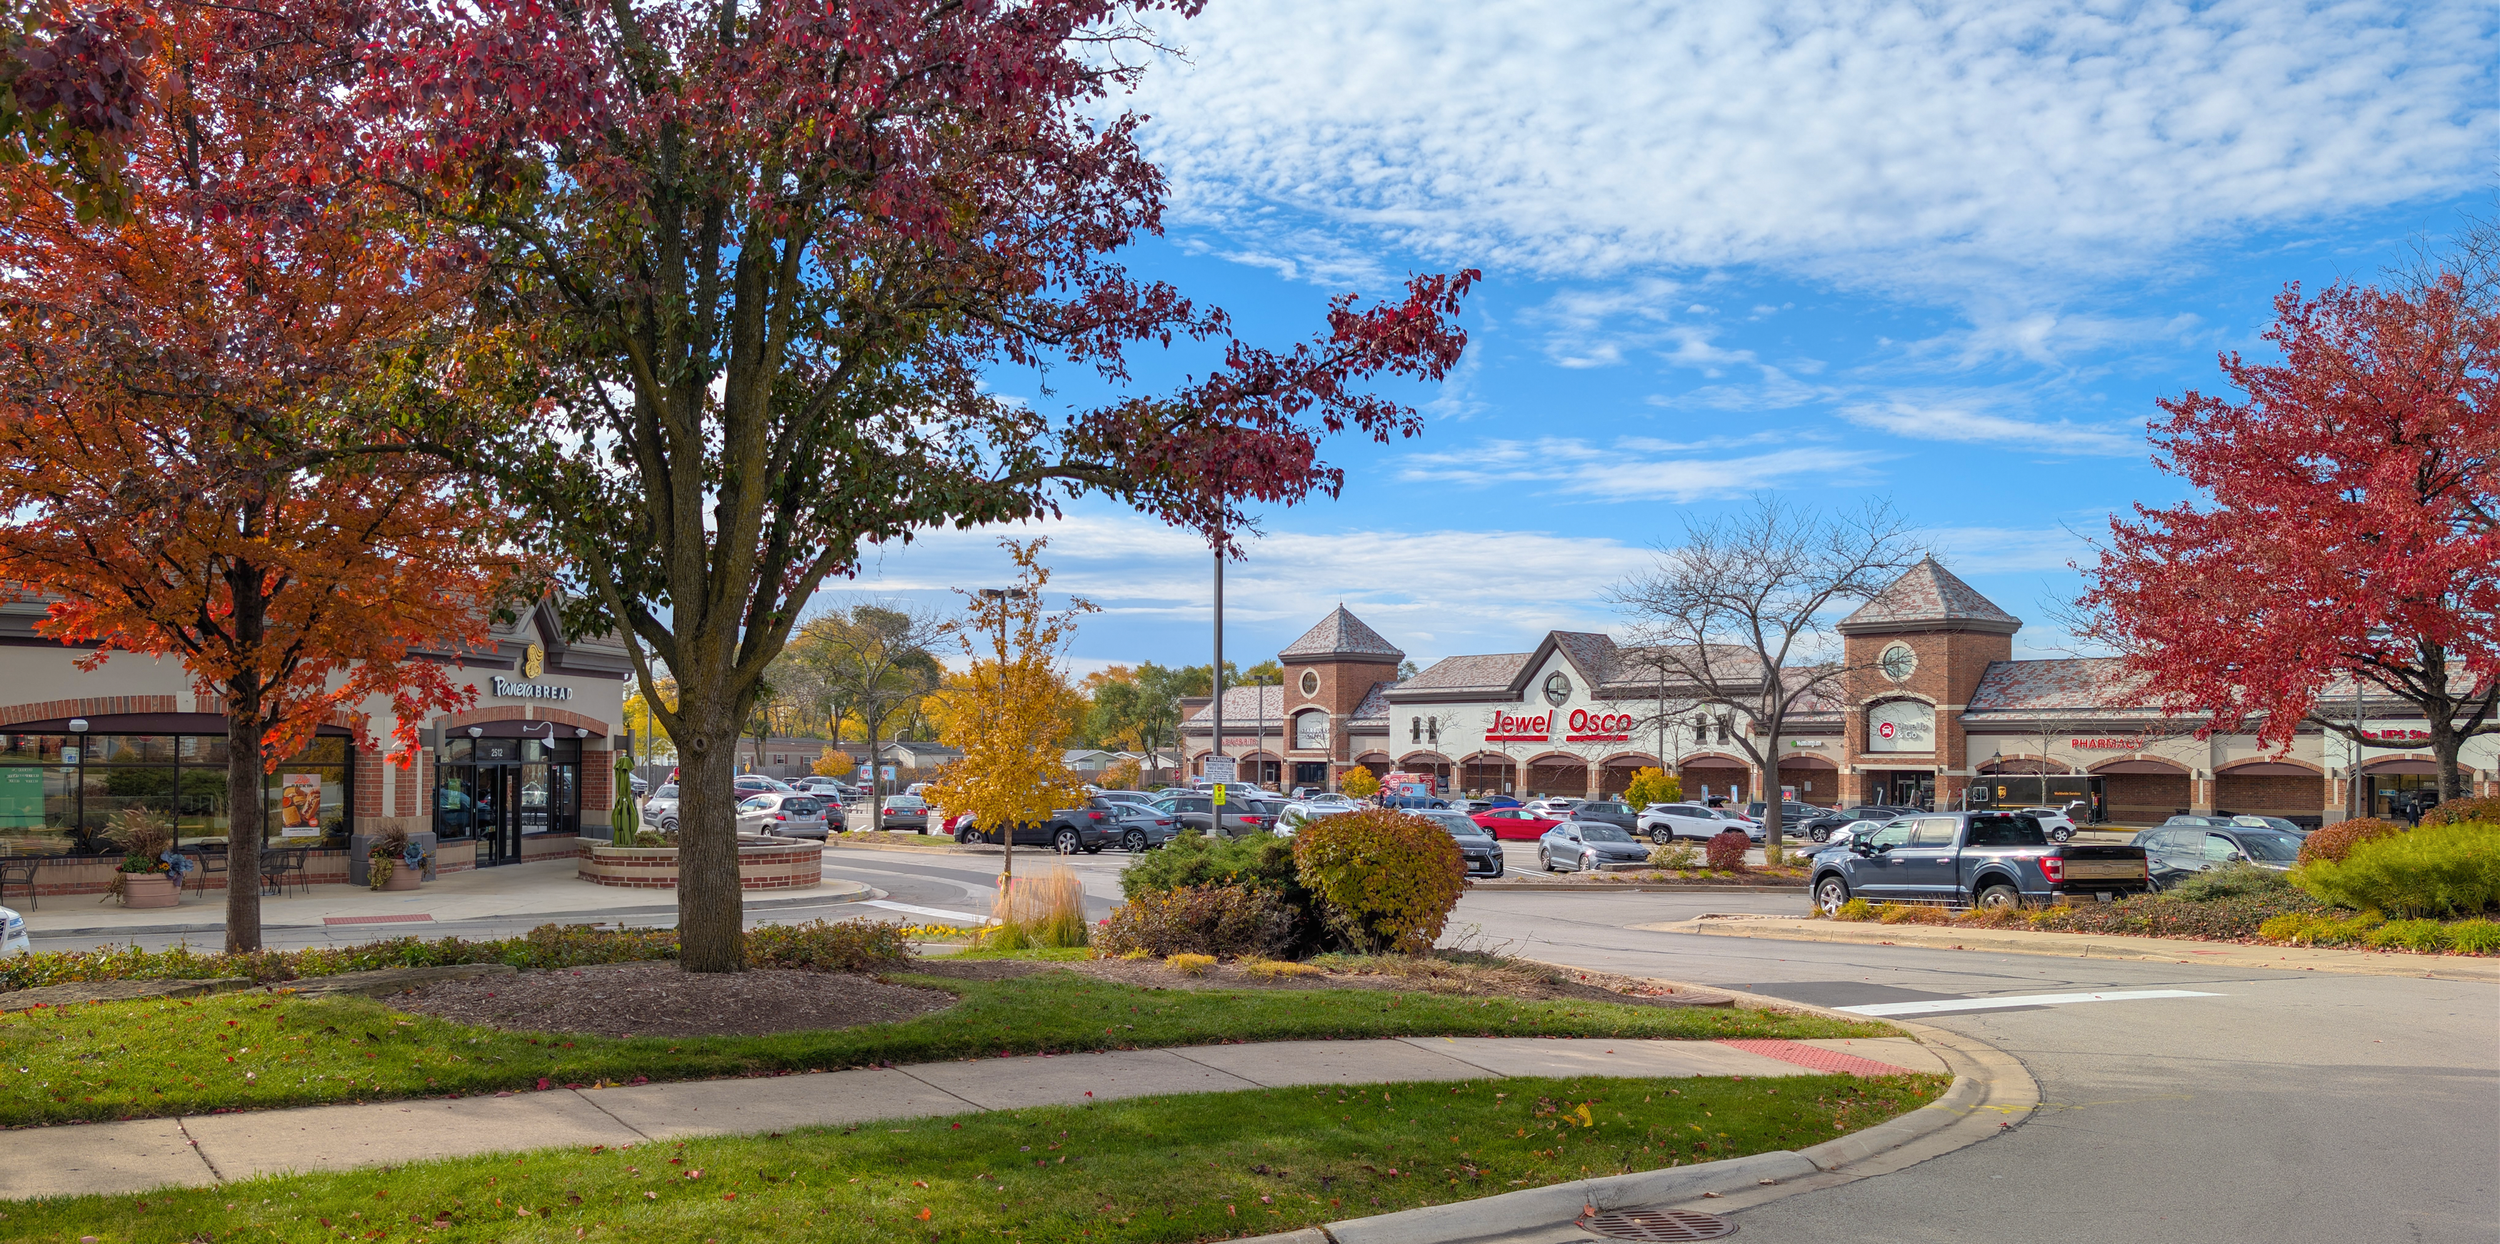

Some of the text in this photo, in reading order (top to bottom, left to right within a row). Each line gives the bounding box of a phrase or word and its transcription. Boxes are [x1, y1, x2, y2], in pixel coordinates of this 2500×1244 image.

[494, 675, 573, 700] Panera BREAD
[1486, 708, 1632, 733] Jewel Osco
[1896, 731, 1918, 739] & Go
[2381, 729, 2406, 740] UPS
[2408, 729, 2431, 740] Sto
[2071, 738, 2143, 749] PHARMACY
[491, 748, 503, 757] 2512
